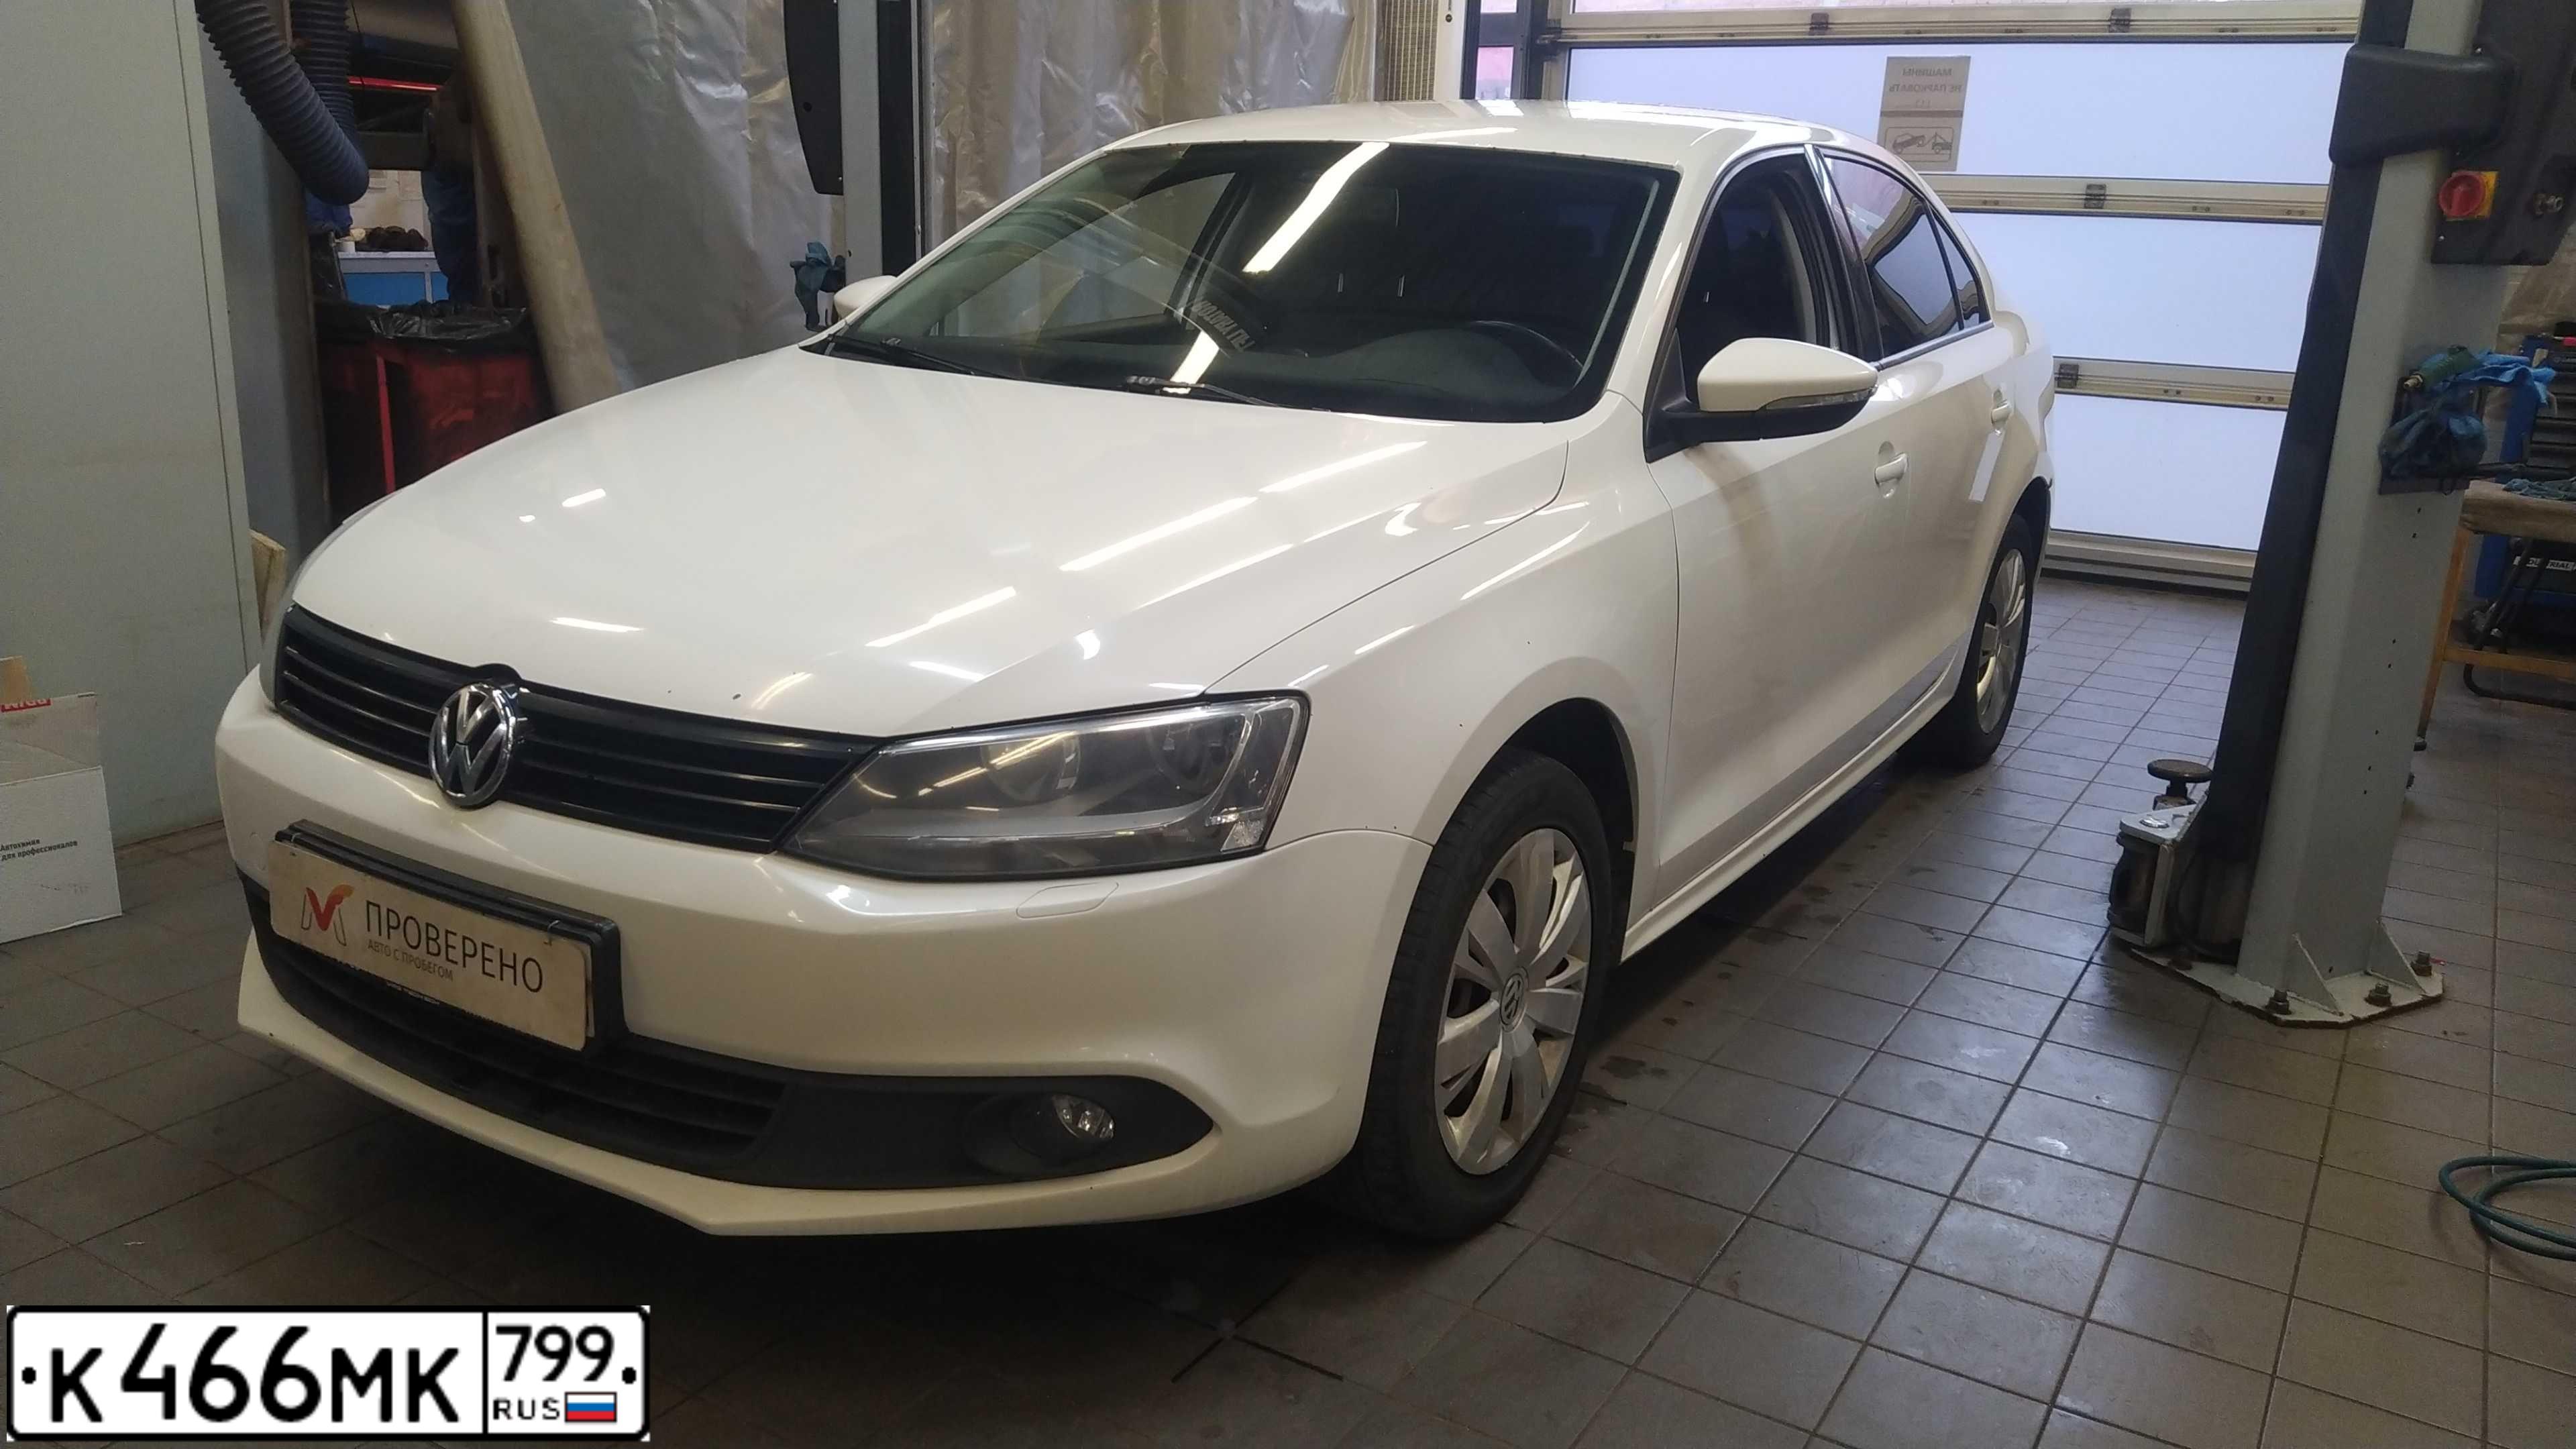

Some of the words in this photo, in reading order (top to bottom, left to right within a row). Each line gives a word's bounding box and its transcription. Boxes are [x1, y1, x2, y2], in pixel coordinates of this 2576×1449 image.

[1, 853, 16, 861] для
[17, 841, 78, 857] профессионалов
[366, 900, 544, 993] ПРОВЕРЕНО
[368, 939, 392, 957] АВТО
[393, 949, 400, 961] С
[402, 951, 454, 981] ПРОБЕГОМ
